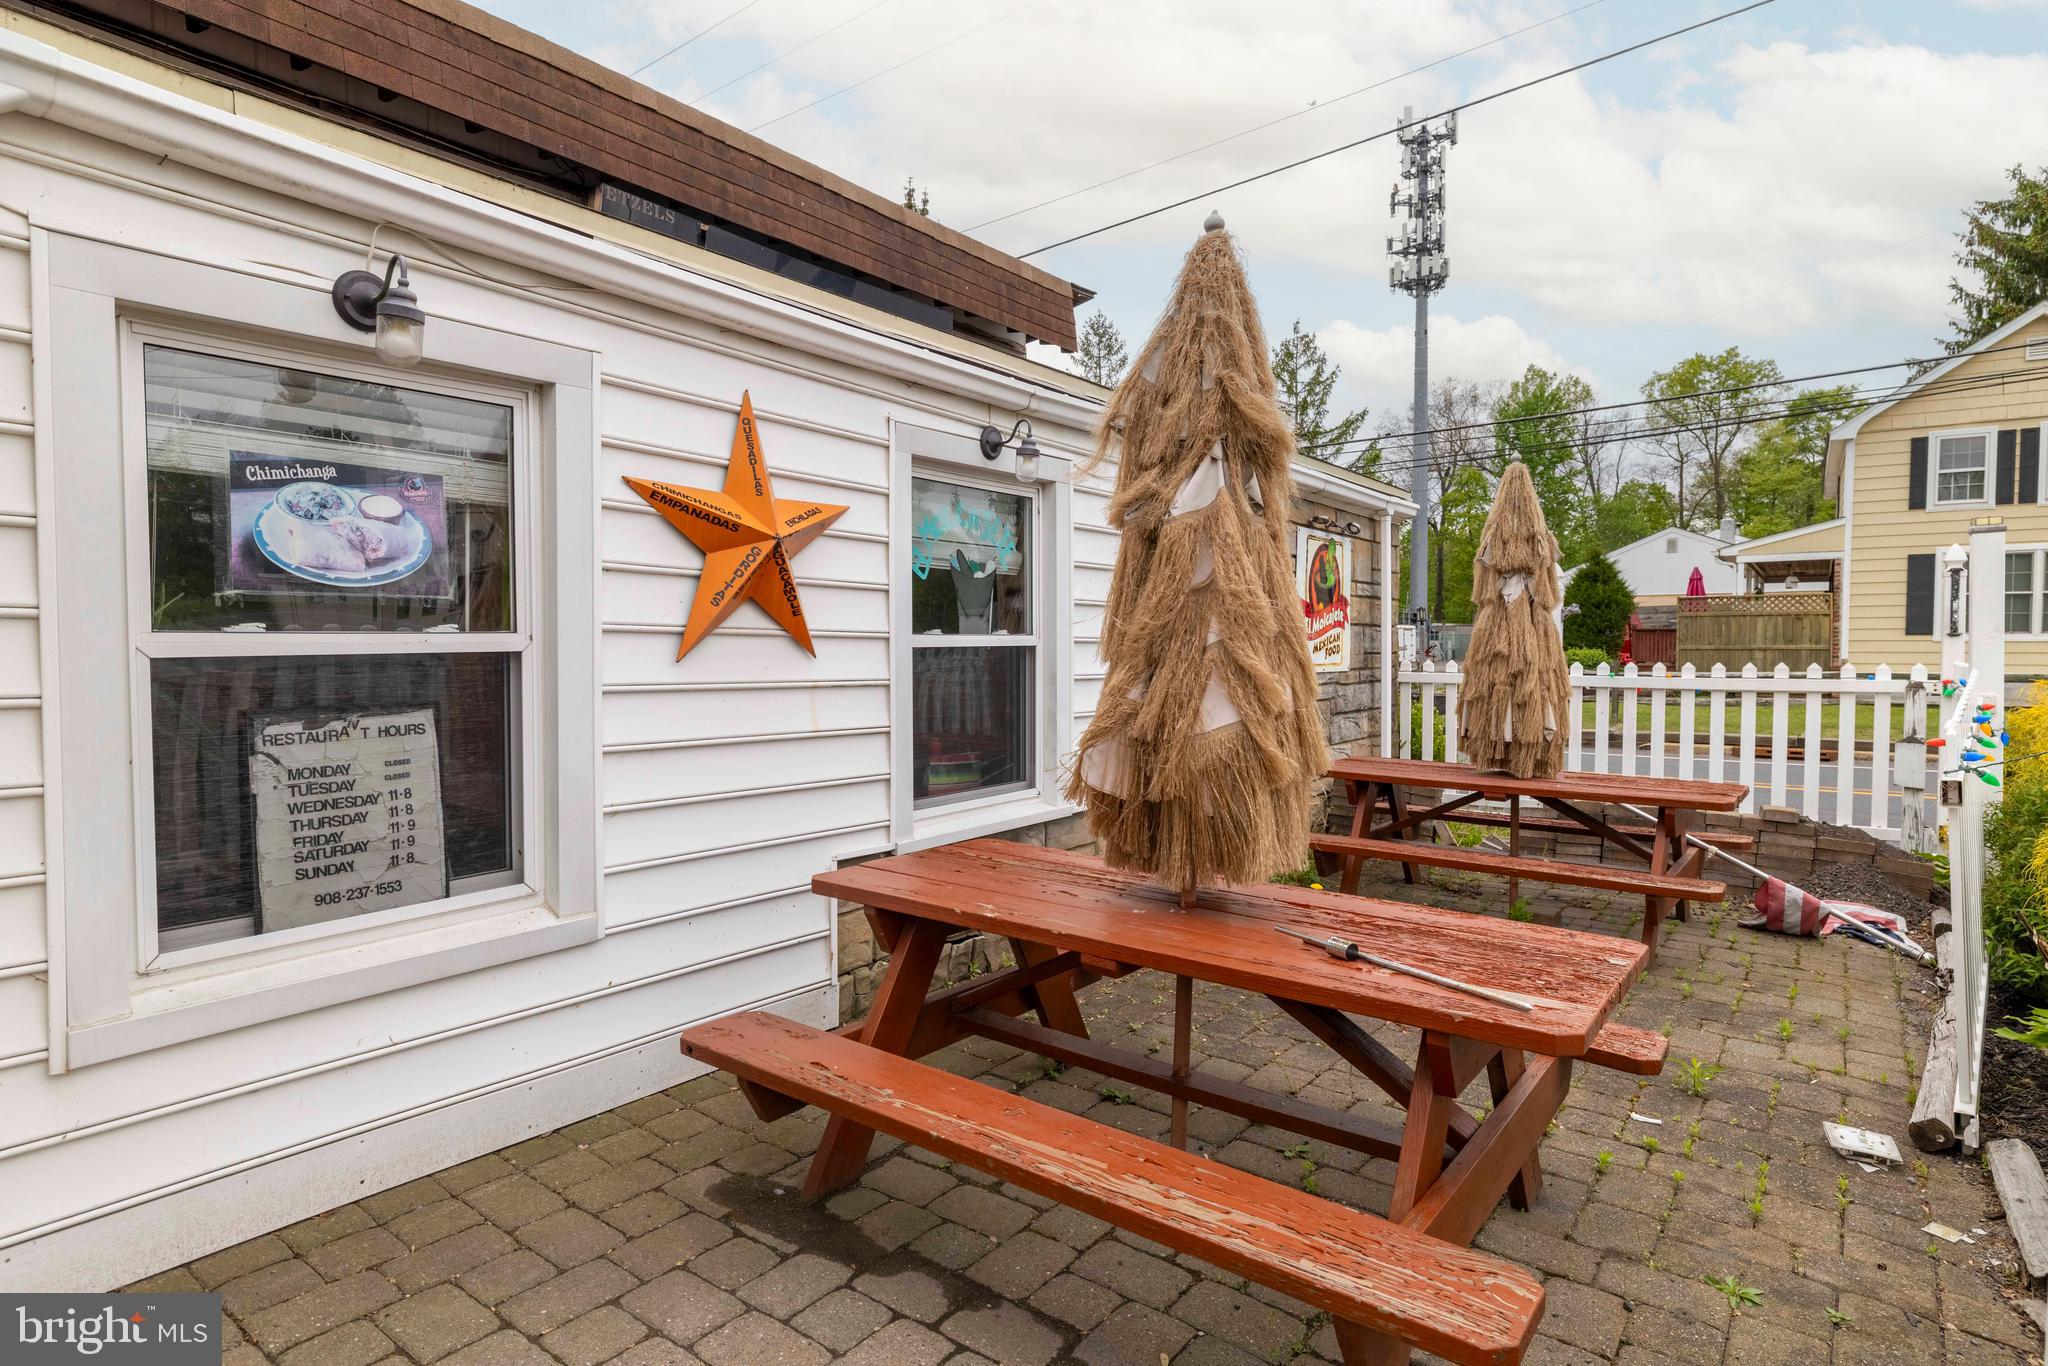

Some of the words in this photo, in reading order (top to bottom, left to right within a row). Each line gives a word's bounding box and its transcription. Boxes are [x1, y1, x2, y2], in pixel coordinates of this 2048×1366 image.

[741, 417, 764, 497] QUESADILAS
[246, 463, 338, 482] Chimichanga
[649, 489, 741, 533] EMPANADAS
[651, 481, 742, 520] CHIMICHANGAS
[785, 507, 822, 528] ENCHILADAS
[710, 545, 762, 608] GORDITAS
[1312, 631, 1341, 655] MEXICAN
[1324, 643, 1341, 660] FOOD
[378, 723, 426, 738] HOURS
[287, 764, 351, 781] MONDAY
[384, 758, 411, 767] CLOSED
[288, 779, 356, 797] TUESDAY
[384, 771, 411, 781] CLOSED
[287, 793, 380, 815] WEDNESDAY
[289, 811, 369, 832] THURSDAY
[293, 831, 344, 849] FRIDAY
[293, 840, 370, 864] SATURDAY
[295, 860, 355, 881] SUNDAY
